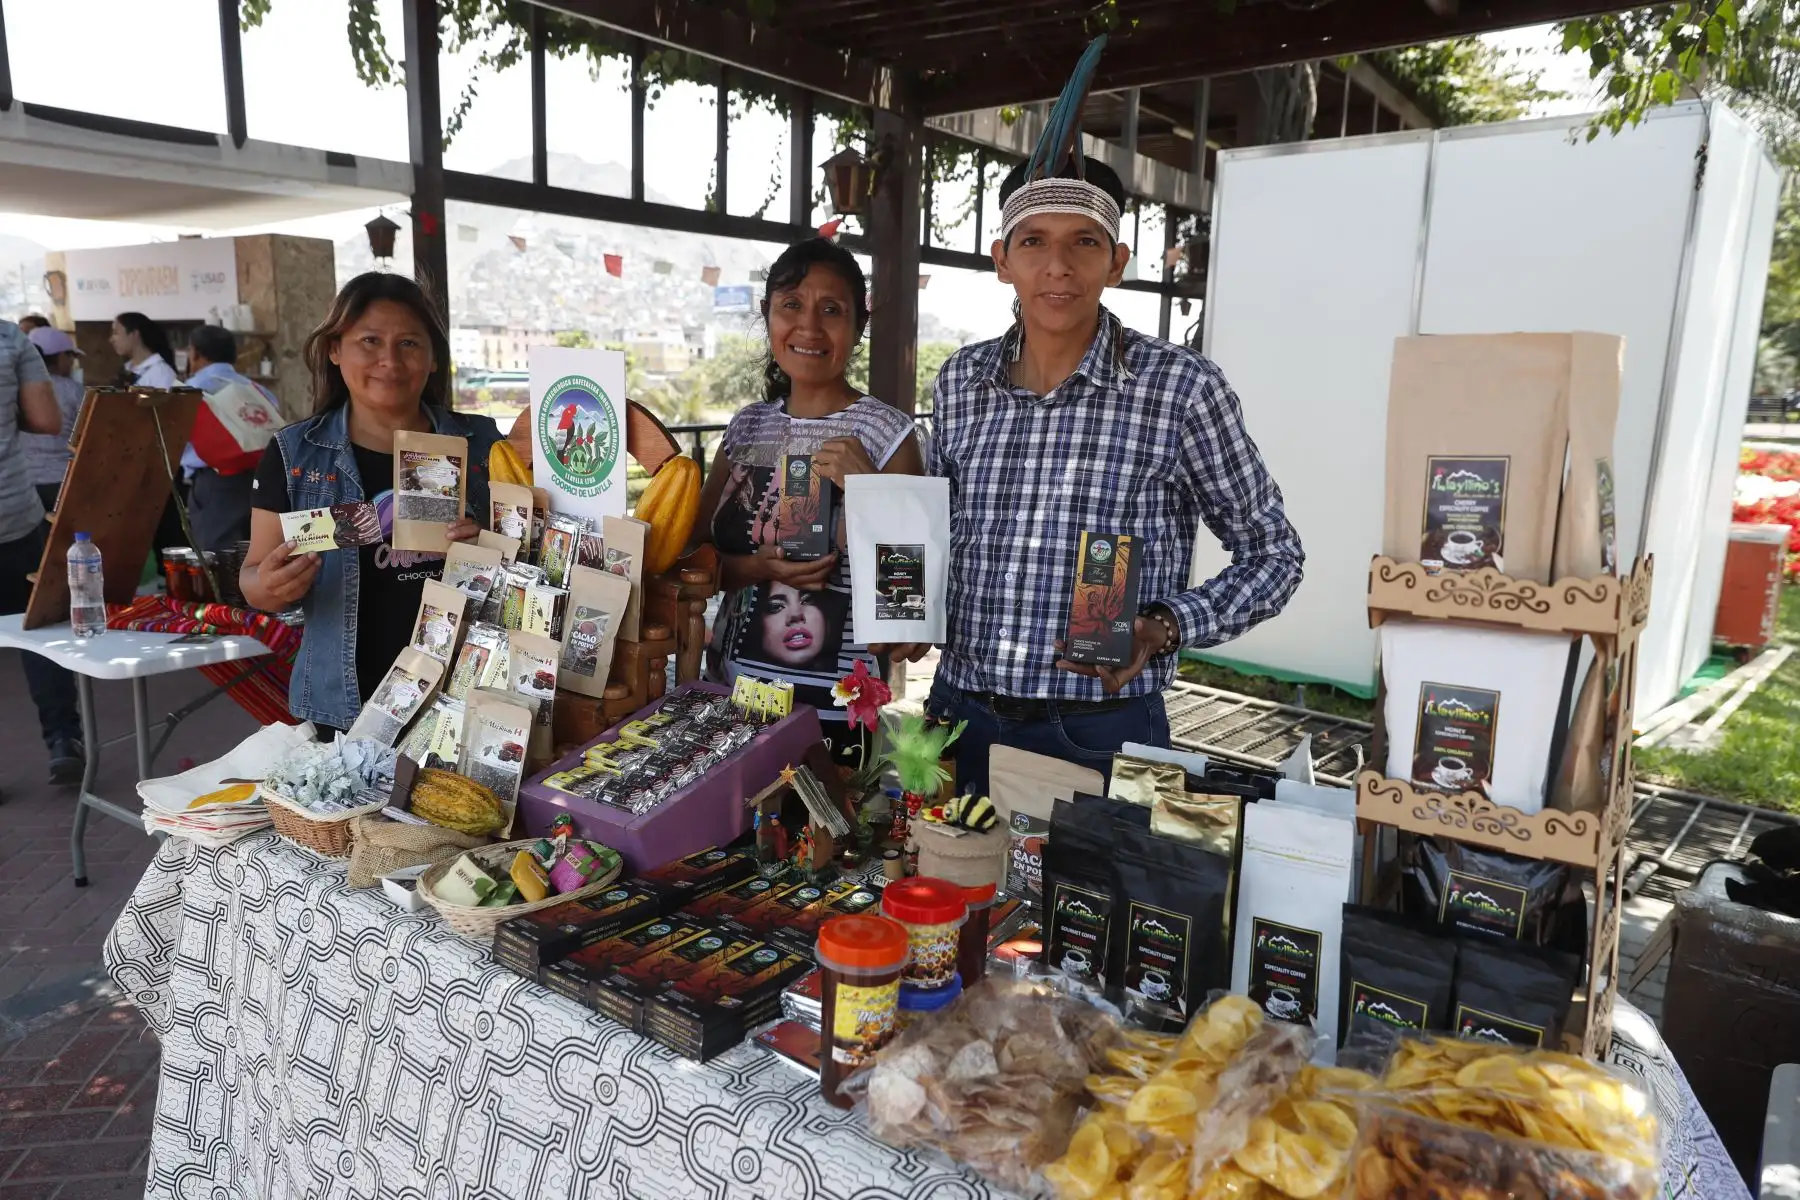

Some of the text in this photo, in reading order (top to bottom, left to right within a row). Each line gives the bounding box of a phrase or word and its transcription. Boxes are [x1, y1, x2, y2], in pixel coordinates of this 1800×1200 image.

[551, 474, 613, 497] COOPACI DE LLAYLLA
[397, 569, 445, 581] CHOCOLA
[572, 631, 597, 644] CACAO
[1013, 849, 1042, 867] CAC
[1013, 860, 1027, 872] EN
[1061, 925, 1097, 941] GOURMET COFFEE
[1161, 951, 1176, 962] COFFEE
[1264, 963, 1306, 980] ESPECIALITY COFFEE
